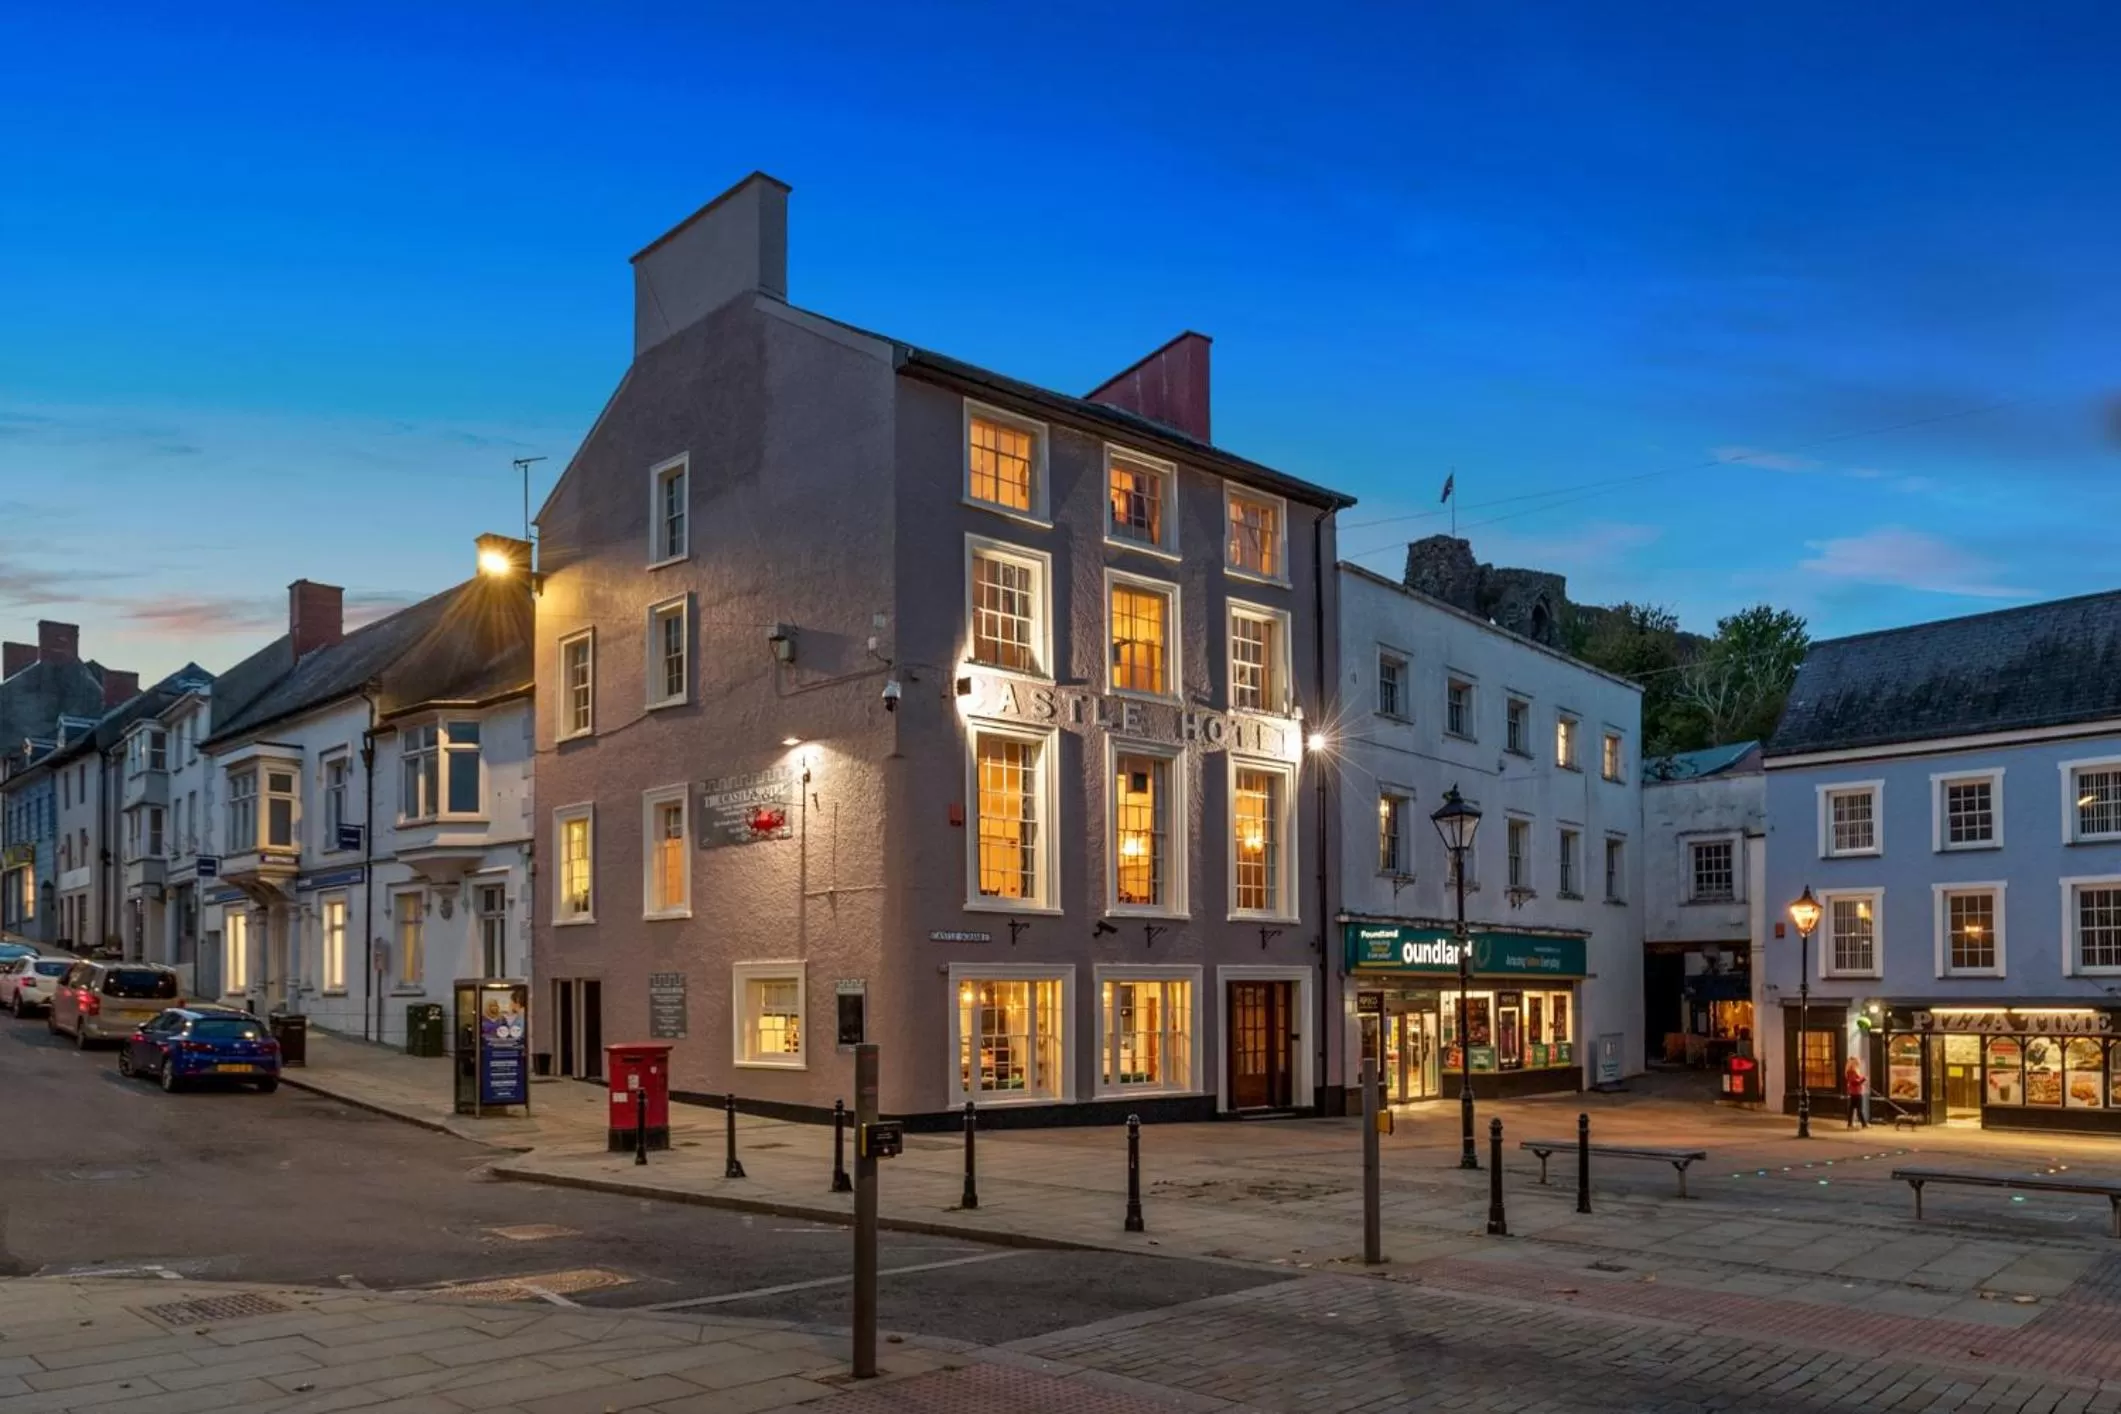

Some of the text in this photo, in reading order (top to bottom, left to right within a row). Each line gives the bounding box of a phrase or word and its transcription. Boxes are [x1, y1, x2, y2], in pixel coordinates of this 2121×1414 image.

[1183, 711, 1300, 757] HOT
[1911, 1011, 2113, 1032] PIZZA TIME
